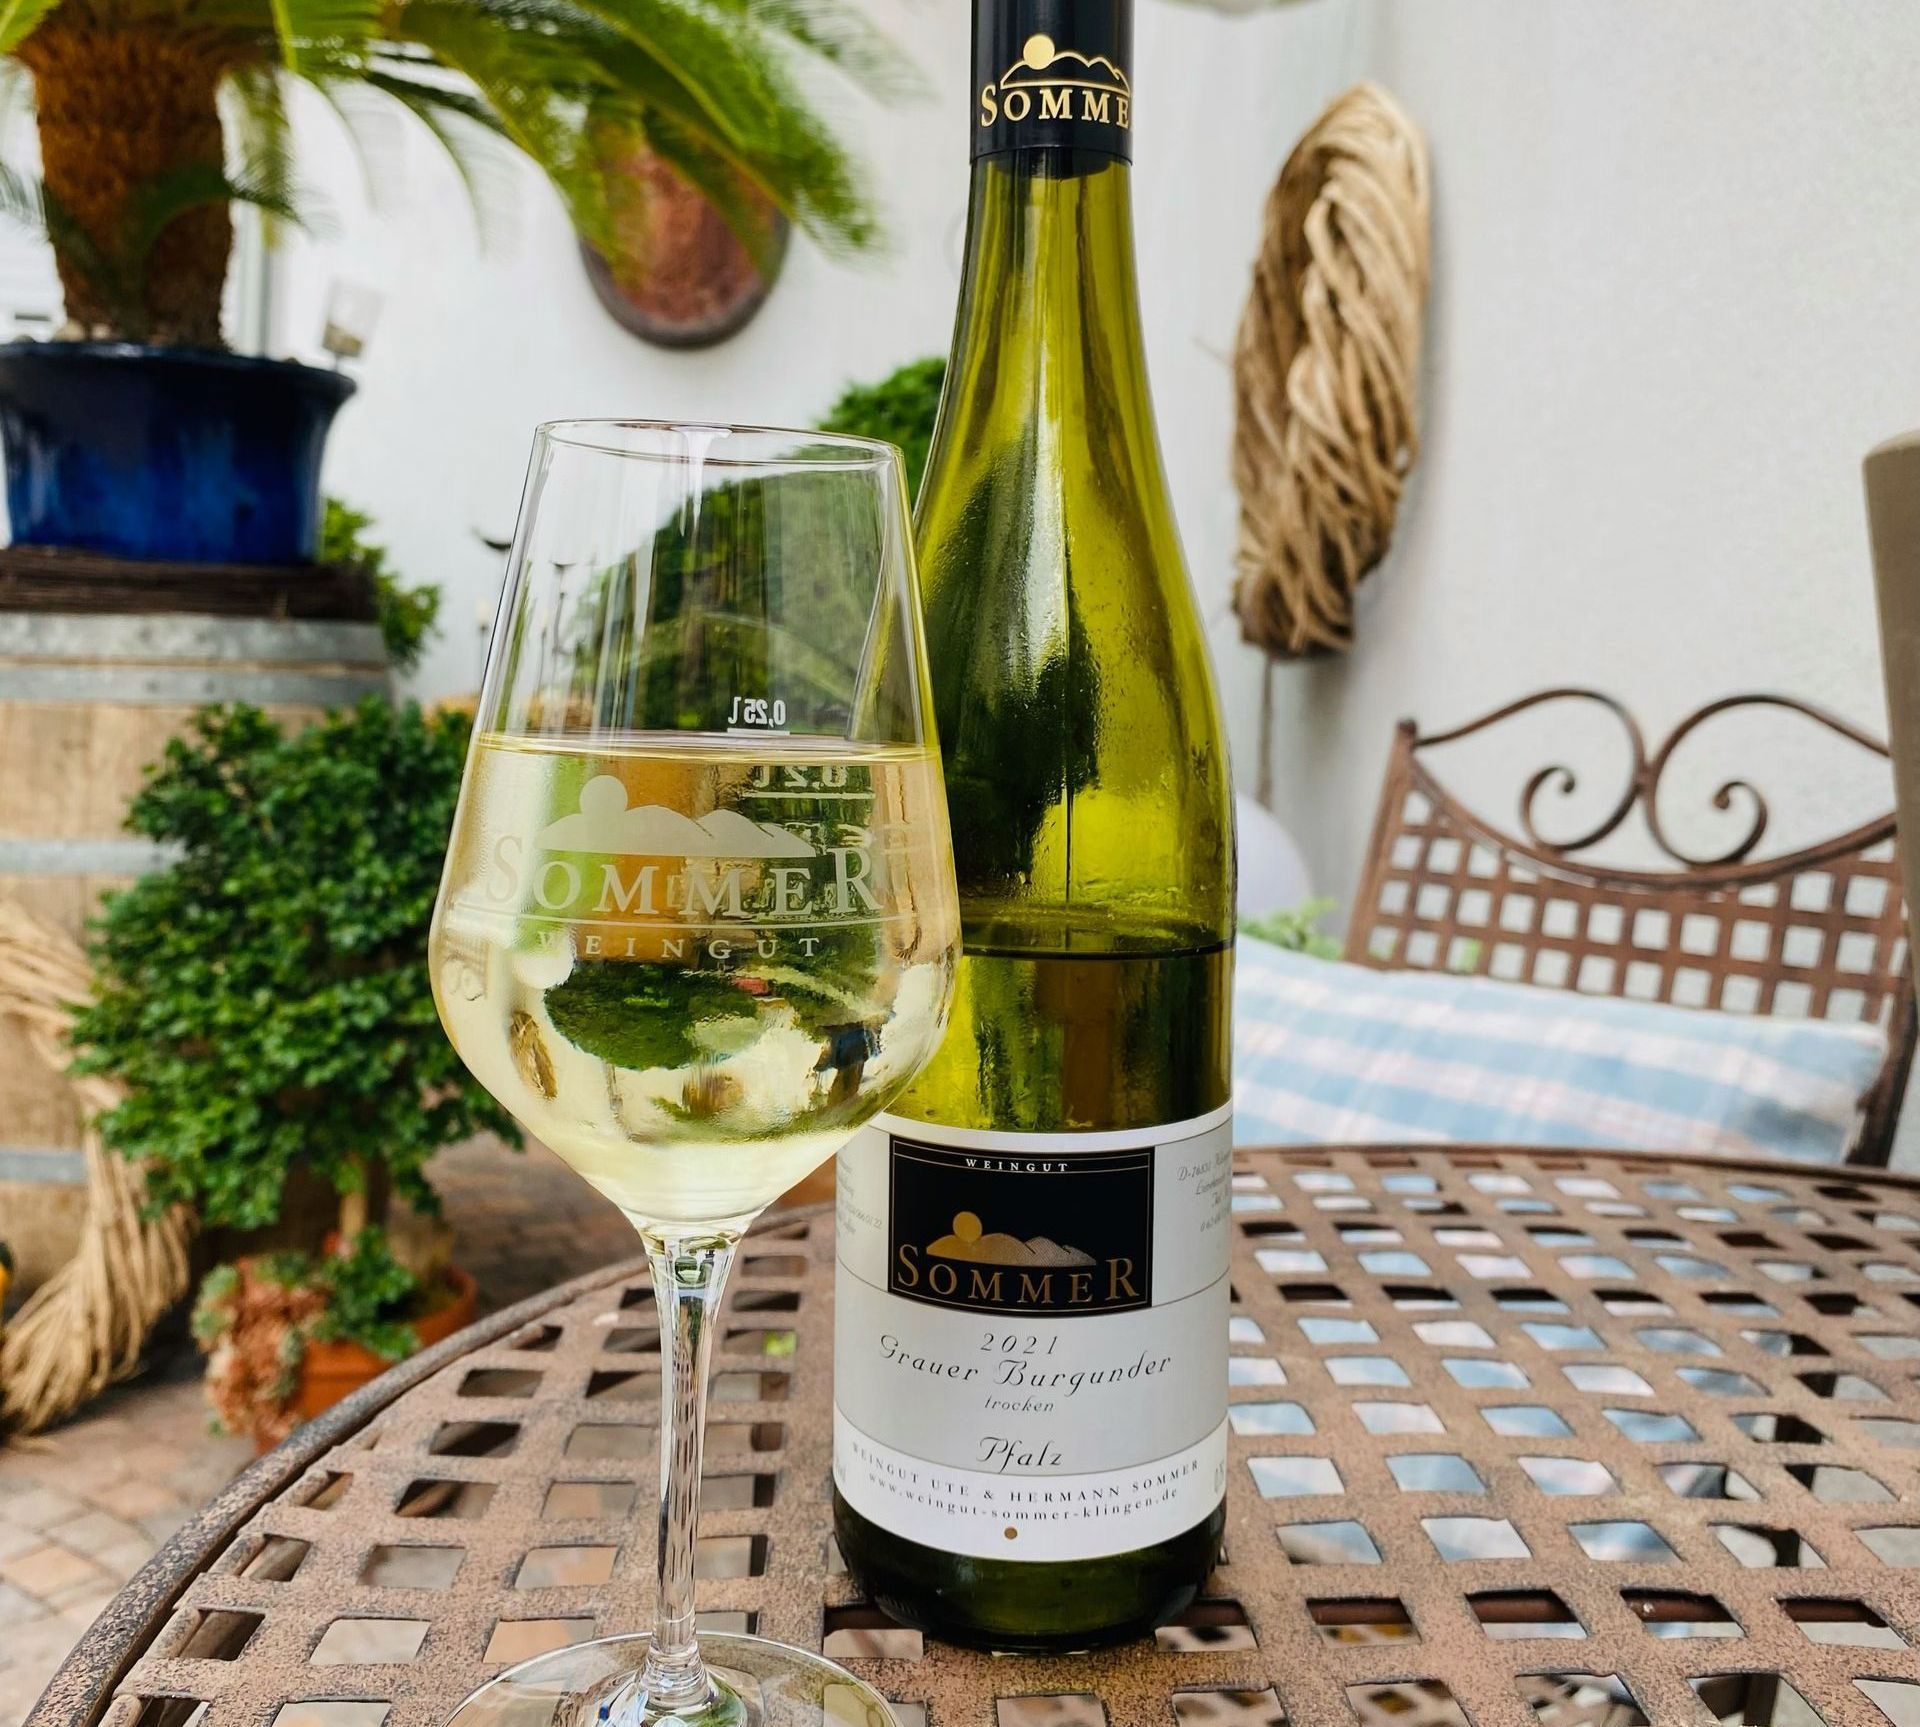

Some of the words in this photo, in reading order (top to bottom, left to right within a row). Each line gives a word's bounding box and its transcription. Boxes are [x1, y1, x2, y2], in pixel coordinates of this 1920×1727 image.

[485, 834, 886, 915] SOMMER
[536, 930, 819, 960] WEINGUT
[965, 1158, 1068, 1172] WEINGUT
[897, 1243, 1140, 1304] SOMMER
[980, 1332, 1058, 1355] 2021
[879, 1334, 979, 1381] Grauer
[993, 1349, 1171, 1398] Burgunder
[984, 1394, 1056, 1413] trocken
[852, 1441, 919, 1484] WEINGUT
[931, 1479, 968, 1497] UTE
[983, 1489, 994, 1500] &
[1010, 1486, 1120, 1503] HERMANN
[1131, 1459, 1199, 1494] SOMMER
[975, 1436, 1063, 1475] Pfalz
[868, 1472, 1178, 1520] www.weingut-sommer-klingen.de
